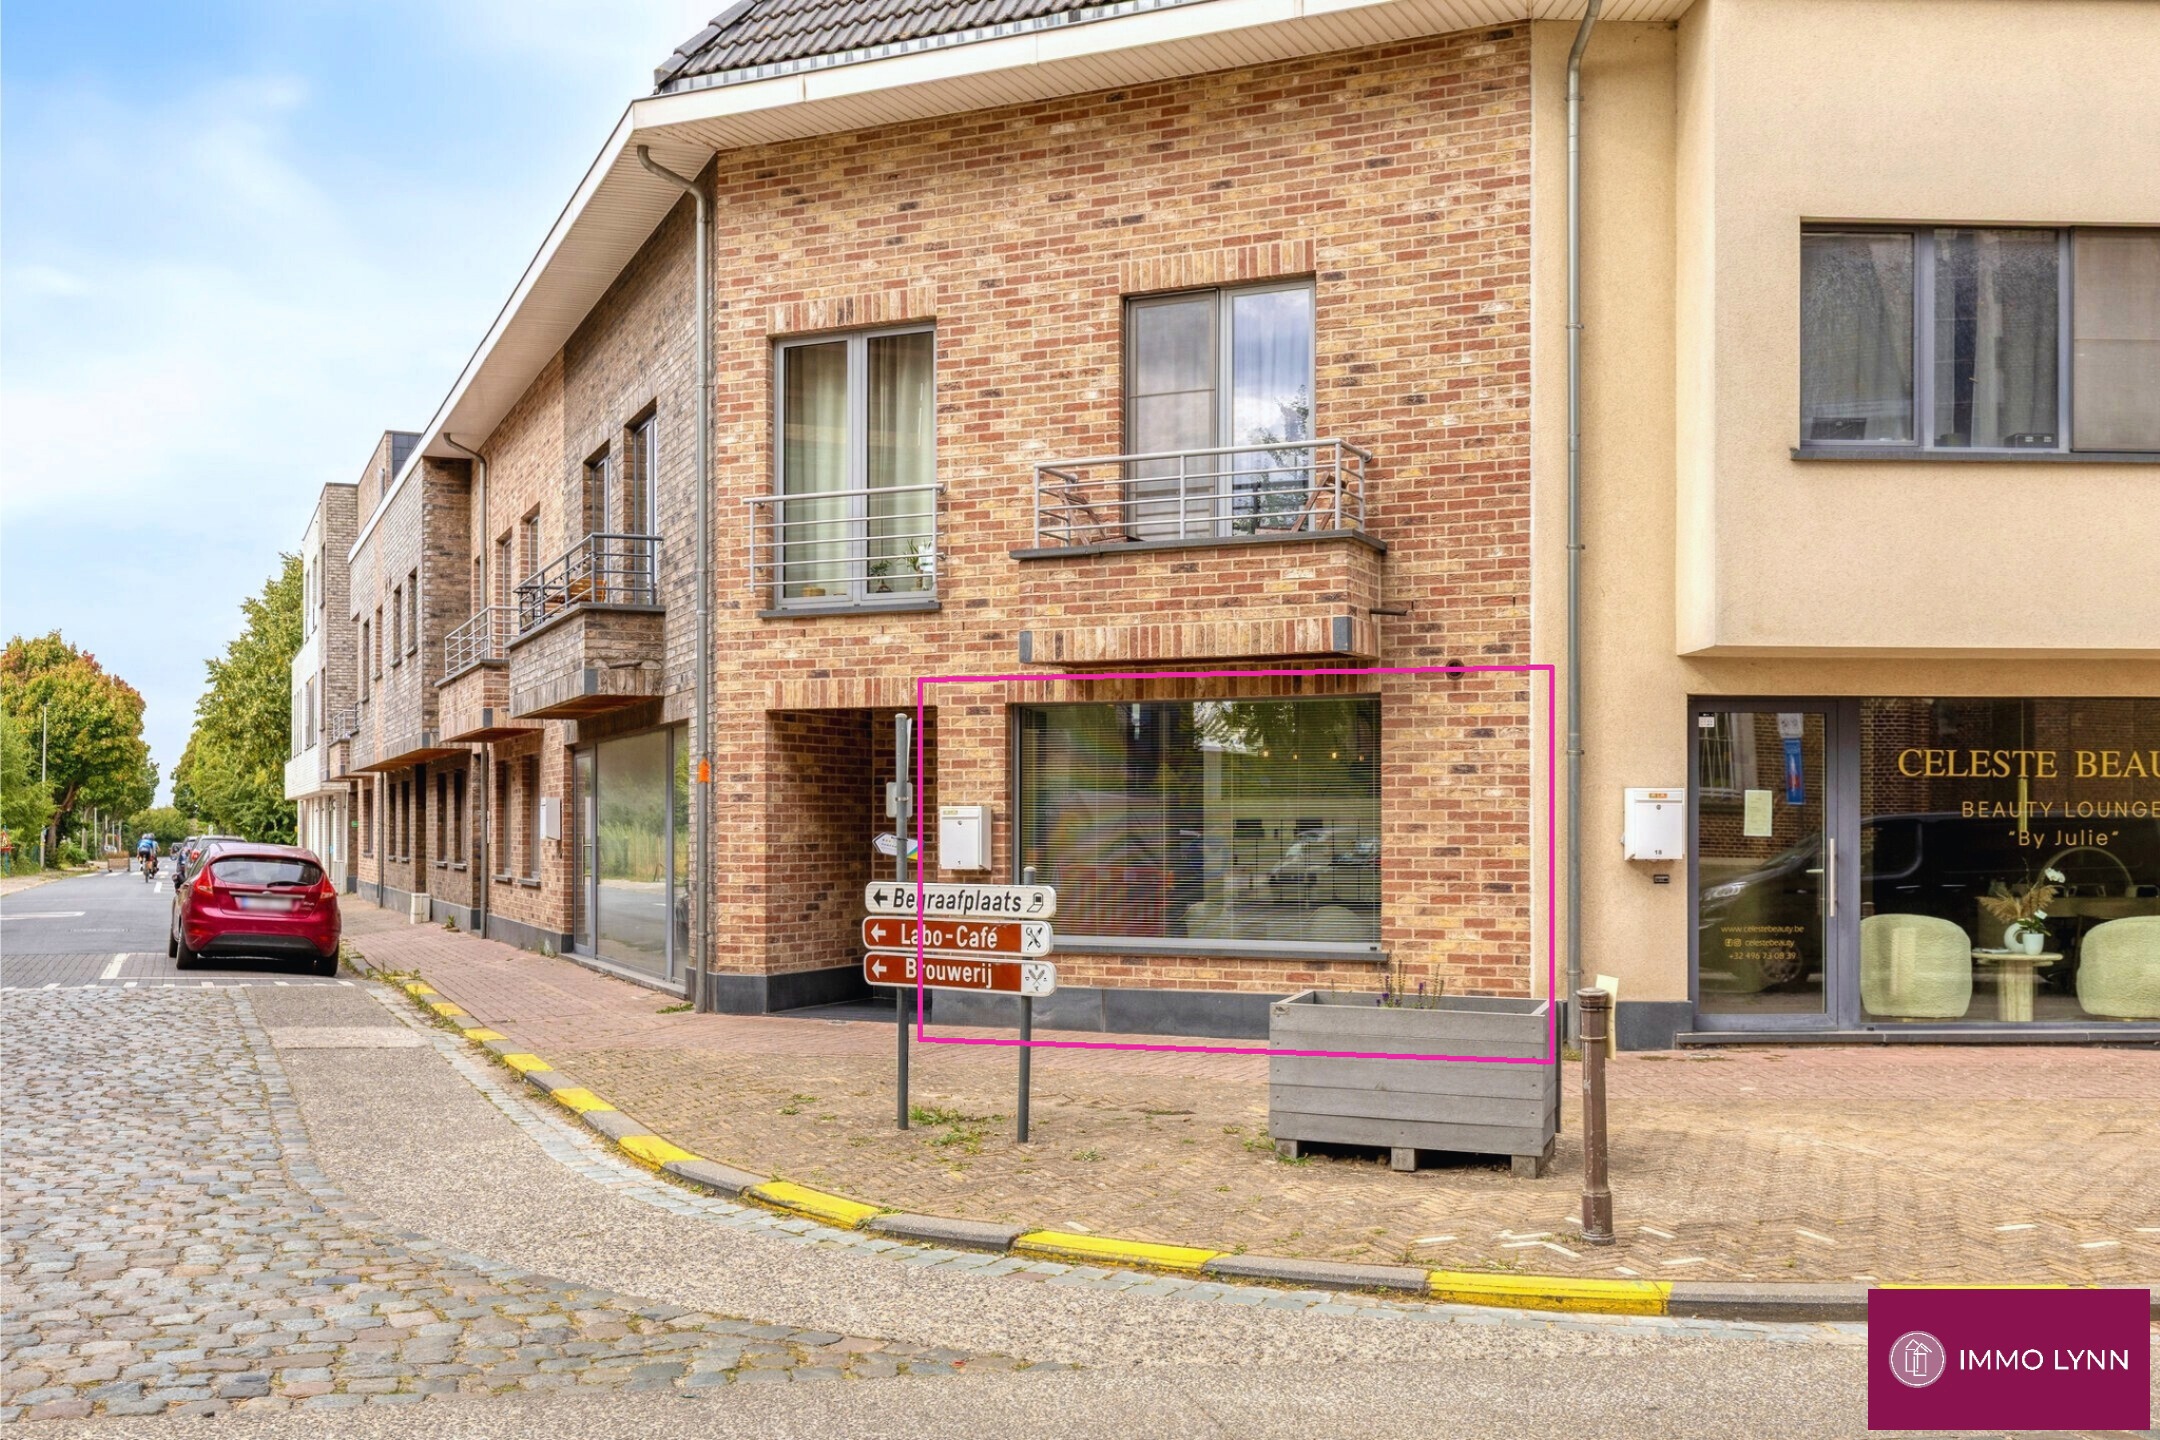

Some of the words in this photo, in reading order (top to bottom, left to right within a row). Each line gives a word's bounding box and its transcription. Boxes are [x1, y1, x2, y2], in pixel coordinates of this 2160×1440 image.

[1897, 748, 2058, 779] CELESTE
[1961, 800, 2053, 818] BEAUTY
[2065, 800, 2160, 818] LOUNGE
[1721, 925, 1804, 934] www.celestebeauty.be
[1745, 939, 1795, 948] celestebeauty
